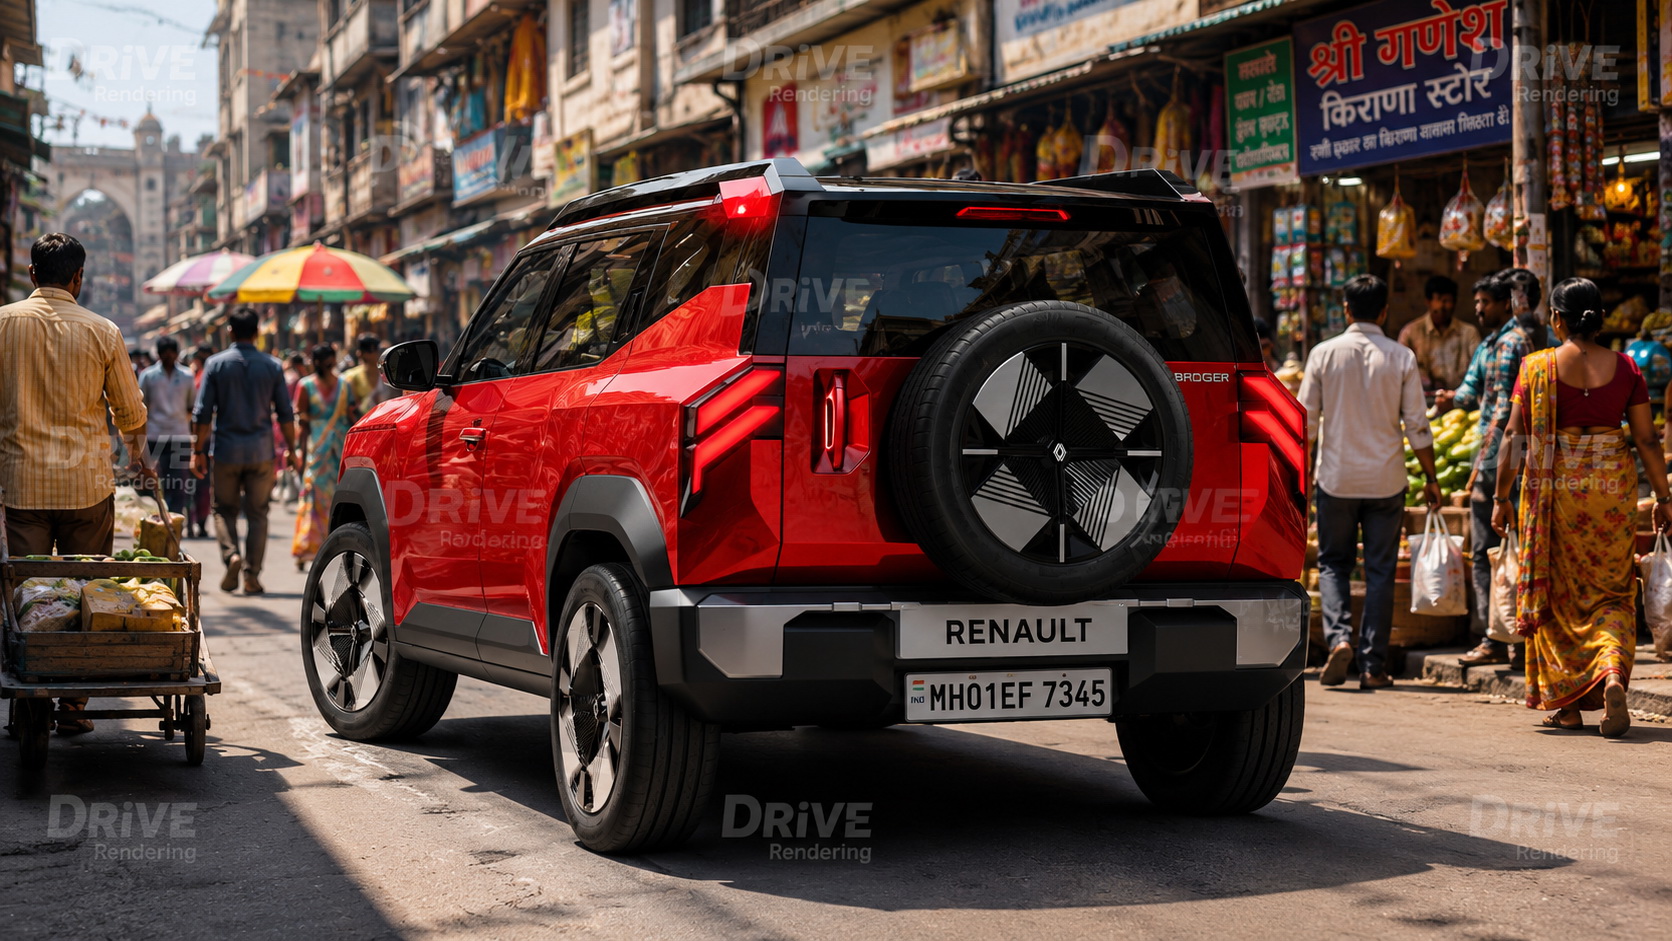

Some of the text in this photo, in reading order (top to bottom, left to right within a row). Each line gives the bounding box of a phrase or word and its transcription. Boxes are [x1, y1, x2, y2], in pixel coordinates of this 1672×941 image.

[1307, 0, 1508, 88] श्री गणेश
[1319, 90, 1417, 131] किराणा
[1424, 63, 1494, 109] स्टोर
[946, 618, 1092, 645] RENAULT
[930, 679, 1105, 711] MH01EF 7345
